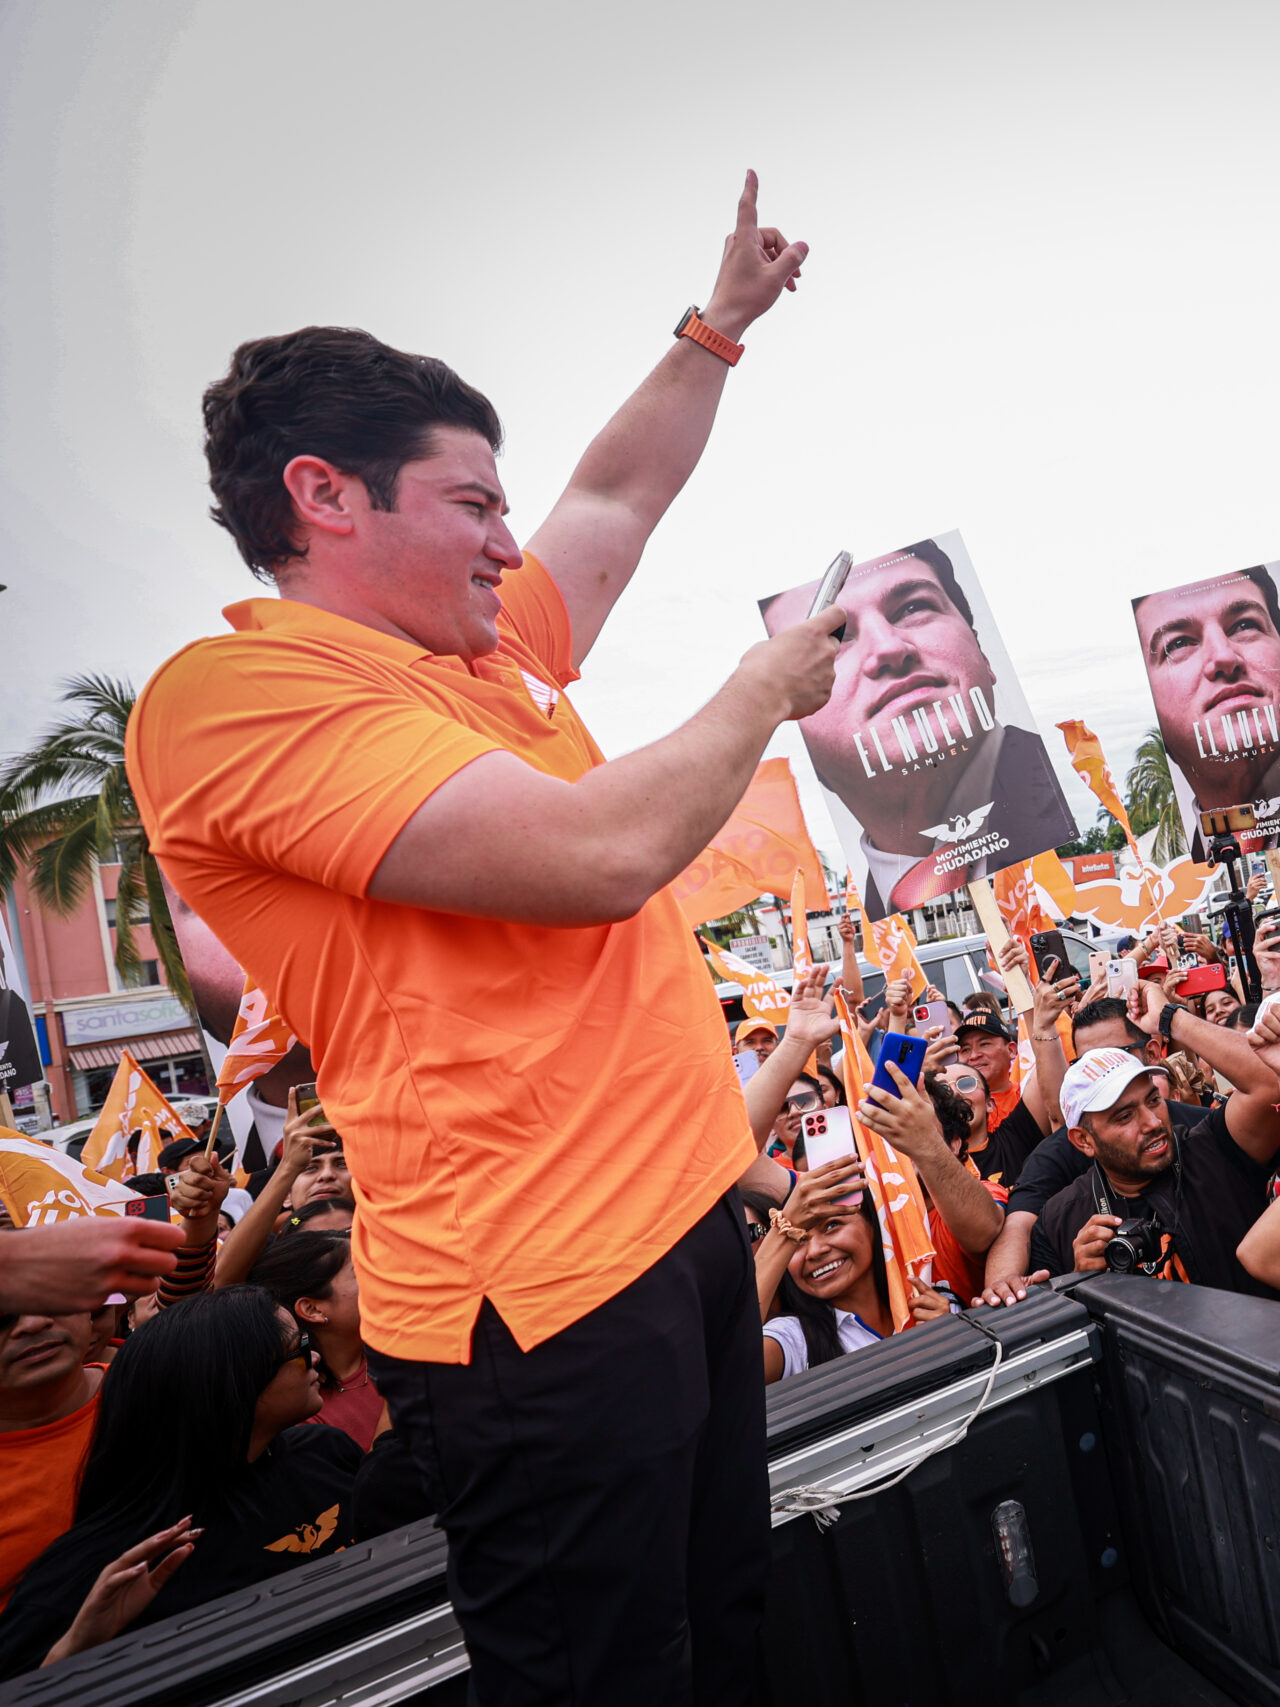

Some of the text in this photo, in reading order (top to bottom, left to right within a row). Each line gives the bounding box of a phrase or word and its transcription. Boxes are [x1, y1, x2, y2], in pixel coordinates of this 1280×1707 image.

[853, 686, 995, 779] EL NUEVO
[1193, 719, 1219, 758] EL
[901, 745, 968, 776] SAMUEL
[1224, 746, 1275, 763] SAMUEL
[933, 838, 1010, 876] CIUDADANO
[935, 832, 999, 863] MOVIMIENTO
[1082, 1064, 1101, 1082] EL
